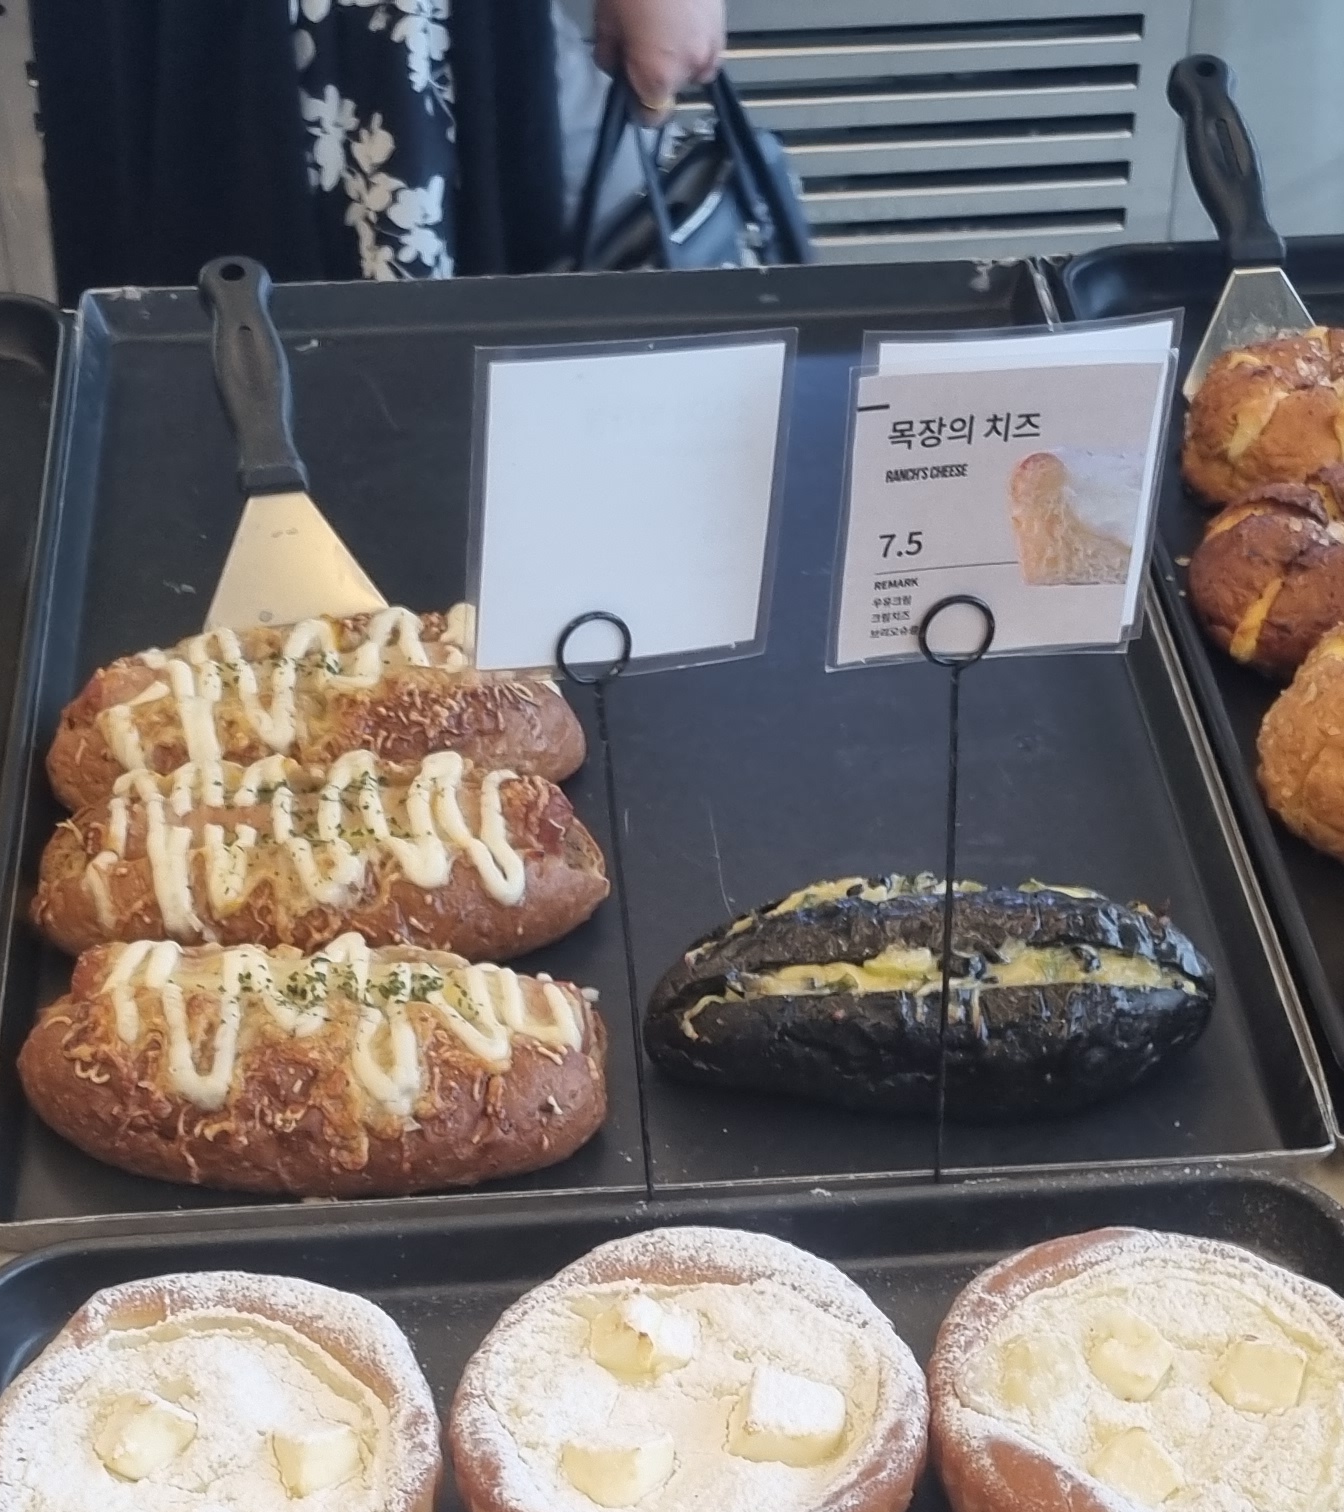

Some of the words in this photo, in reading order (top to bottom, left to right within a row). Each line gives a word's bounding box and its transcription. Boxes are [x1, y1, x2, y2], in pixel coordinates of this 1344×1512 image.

[887, 413, 975, 450] 목장의
[983, 412, 1041, 443] 치즈
[885, 466, 929, 483] RANCH'S
[929, 463, 969, 480] CHEESE
[878, 531, 923, 558] 7.5
[873, 577, 919, 590] REMARK
